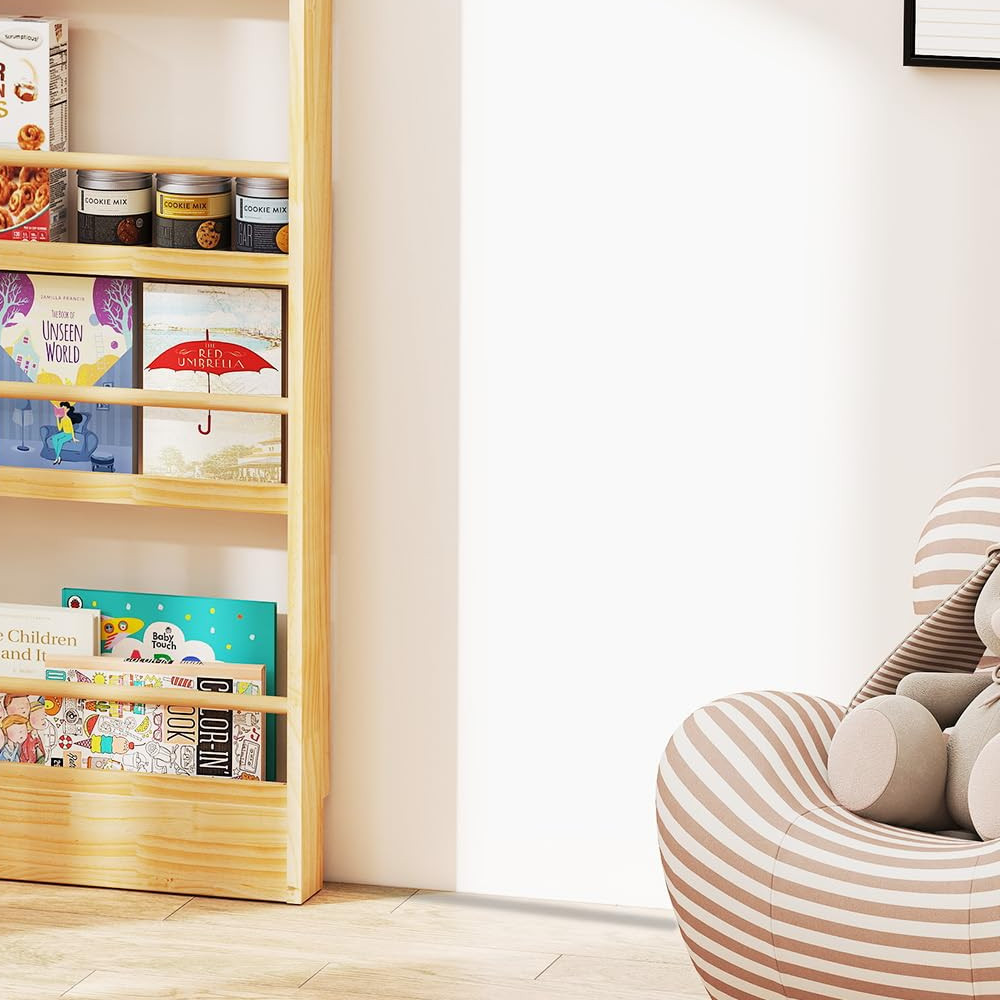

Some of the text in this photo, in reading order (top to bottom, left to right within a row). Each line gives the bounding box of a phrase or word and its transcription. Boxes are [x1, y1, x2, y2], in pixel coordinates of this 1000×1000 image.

[84, 197, 112, 206] COOKIE
[164, 201, 191, 209] COOKIE
[243, 205, 288, 214] COOKIE MIX
[42, 319, 83, 342] UNSEEN
[45, 341, 80, 364] WORLD
[199, 348, 223, 358] RED
[178, 357, 245, 369] UMBRELLA
[7, 629, 77, 647] Children
[152, 631, 174, 644] Baby
[151, 640, 177, 650] Touch
[1, 647, 47, 662] and It
[167, 704, 196, 743] OOK
